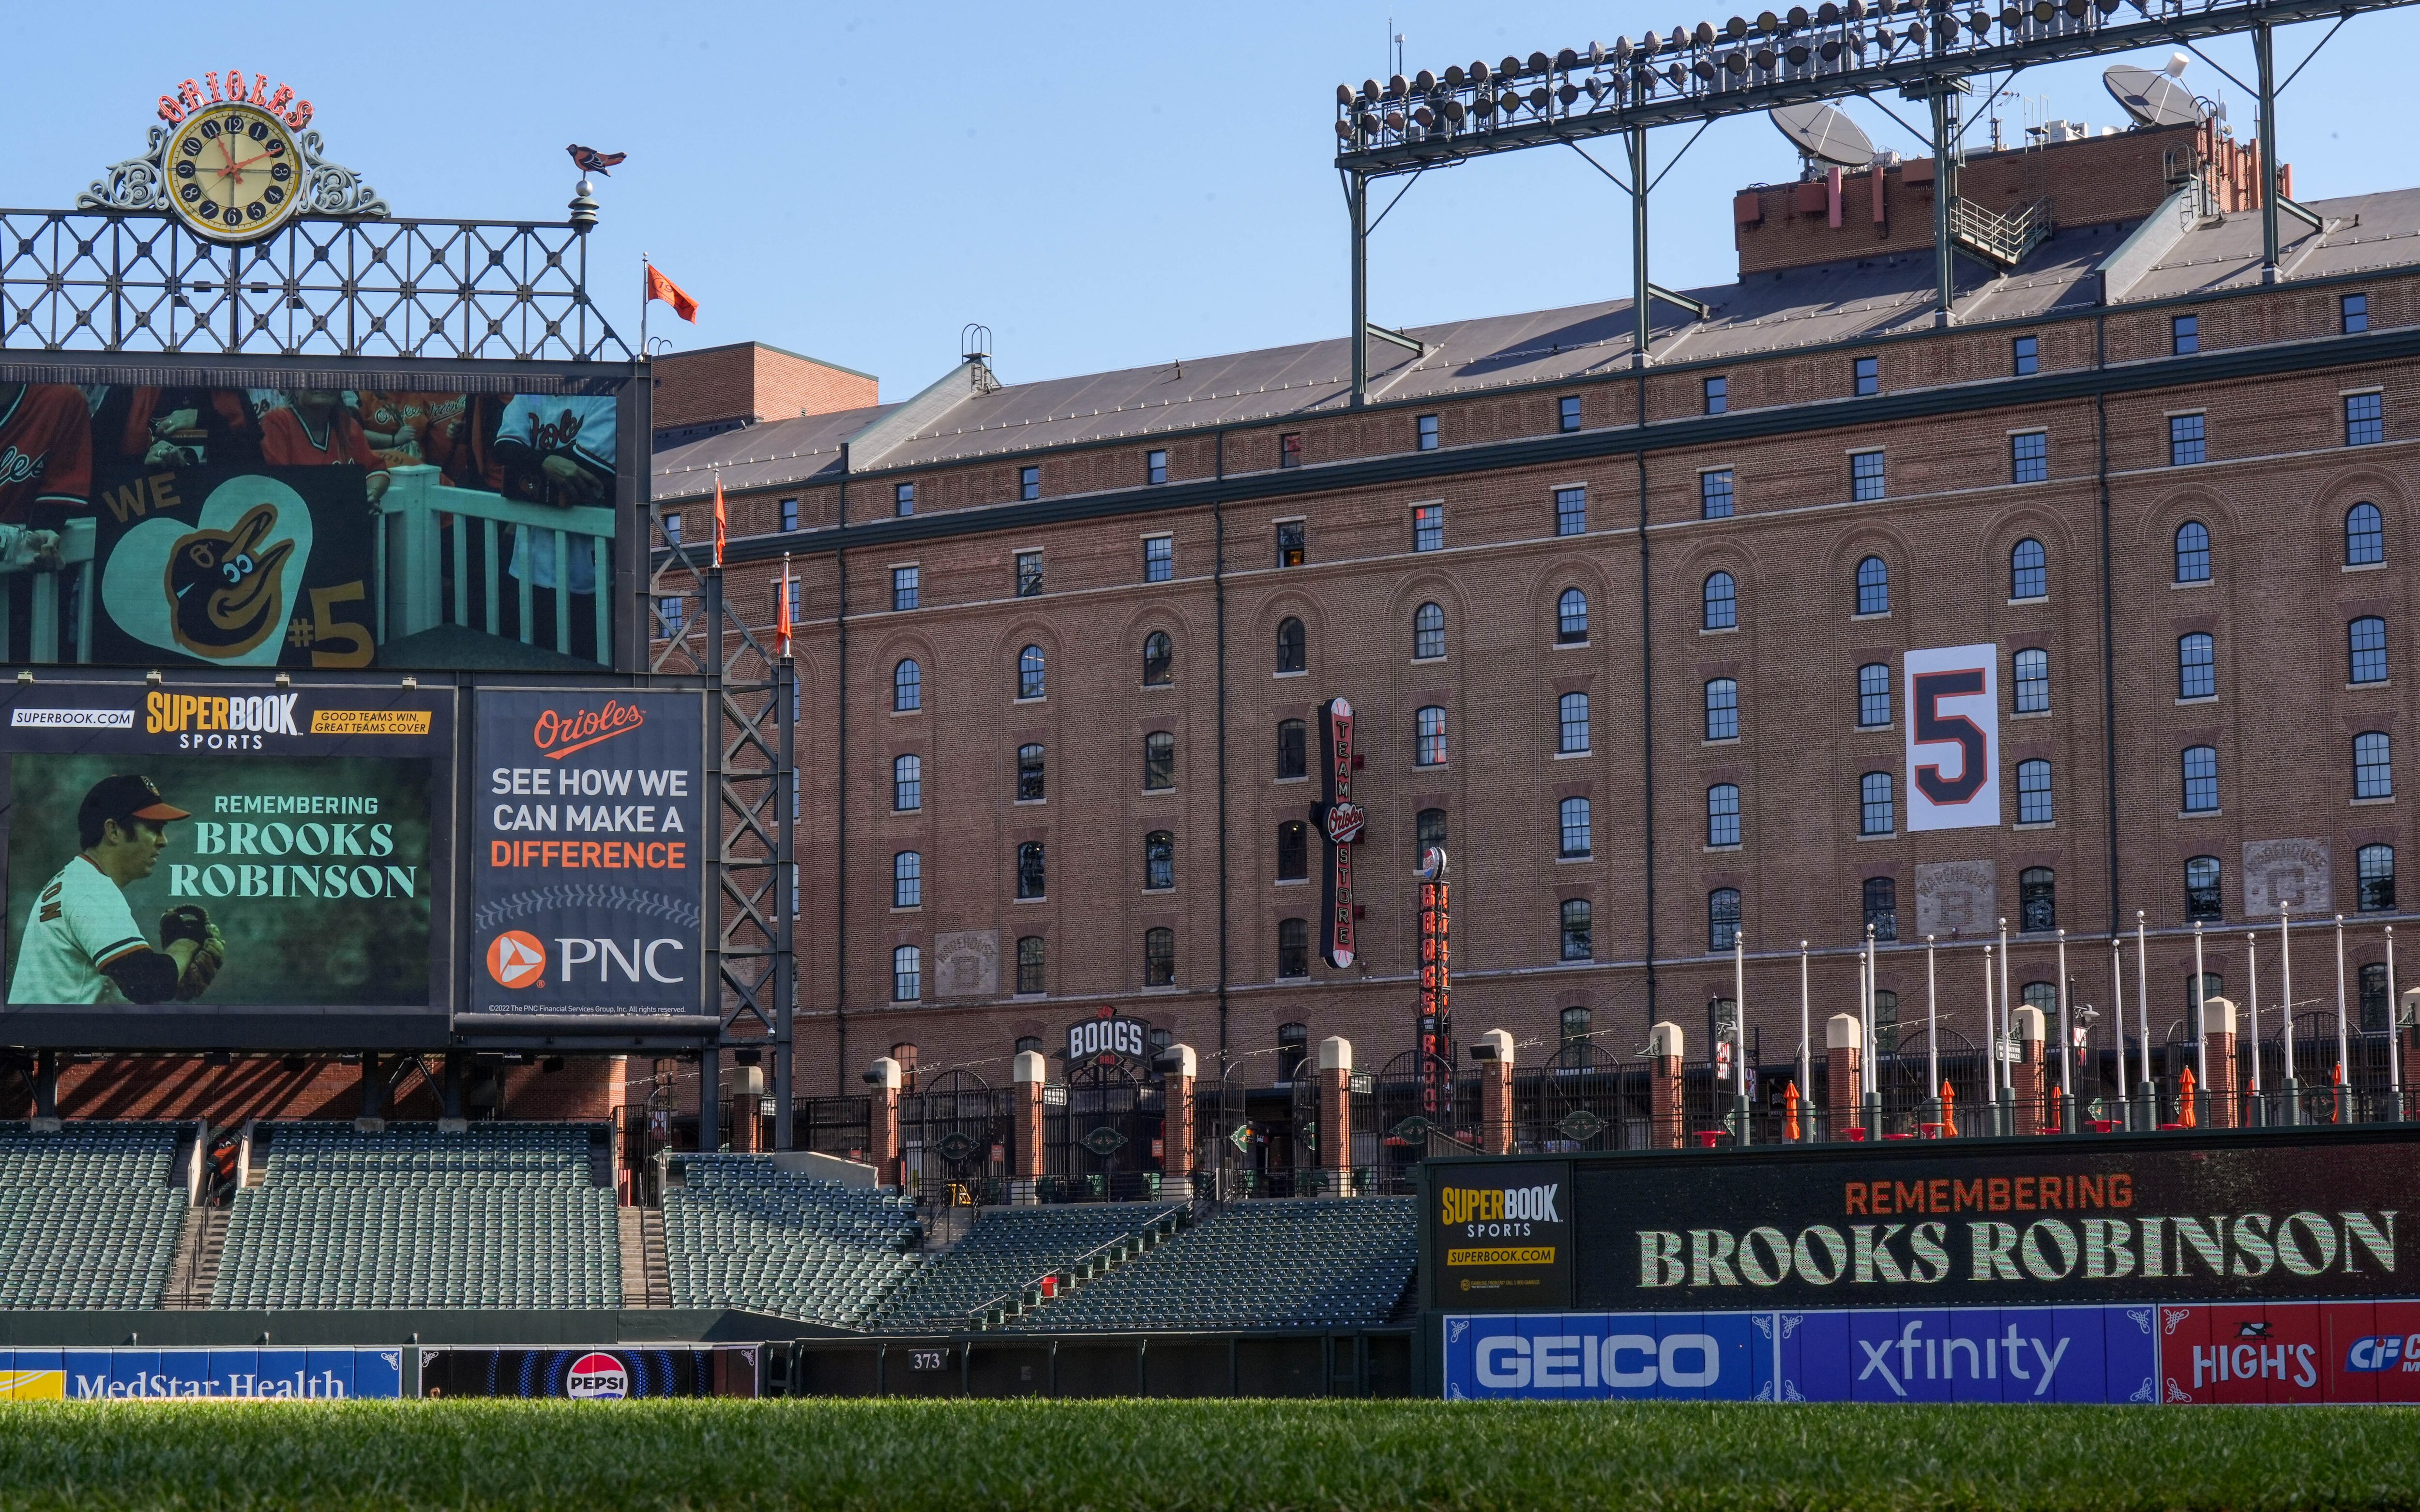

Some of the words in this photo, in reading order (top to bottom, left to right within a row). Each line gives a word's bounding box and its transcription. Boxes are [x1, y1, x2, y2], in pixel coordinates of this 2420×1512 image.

[158, 70, 315, 131] ORIOLES
[203, 123, 218, 138] 11
[227, 118, 243, 132] 12
[253, 125, 262, 137] 1
[184, 139, 200, 155] 10
[178, 165, 193, 174] 9
[274, 167, 287, 177] 3
[184, 188, 198, 199] 8
[268, 189, 281, 202] 4
[203, 205, 218, 215] 7
[227, 210, 237, 224] 6
[251, 204, 261, 218] 5
[102, 472, 181, 522] WE
[16, 713, 130, 724] SUPERBOOK.COM
[147, 691, 298, 736] SUPERBOOK
[321, 712, 356, 721] GOOD
[359, 713, 393, 721] TEAMS
[396, 713, 419, 722] WIN,
[180, 734, 262, 749] SPORTS
[315, 723, 349, 732] GREAT
[352, 723, 385, 732] TEAMS
[389, 723, 425, 733] COVER
[534, 700, 645, 759] Orioles
[1912, 668, 1987, 806] 5
[1337, 721, 1349, 797] TEAM
[492, 768, 551, 795] SEE
[560, 769, 632, 796] HOW
[636, 770, 688, 796] WE
[215, 796, 378, 815] REMEMBERING
[493, 804, 556, 831] CAN
[566, 805, 655, 832] MAKE
[661, 806, 684, 832] A
[1329, 804, 1364, 838] Orioles
[194, 822, 393, 857] BROOKS
[491, 840, 686, 868] DIFFERENCE
[168, 864, 418, 898] ROBINSON
[1338, 848, 1349, 943] STORE
[555, 938, 684, 983] PNC
[1422, 884, 1436, 1015] BOOGS
[1071, 1020, 1142, 1059] BOOG'S
[1100, 1055, 1116, 1064] BBQ
[1442, 1183, 1559, 1225] SUPERBOOK
[1845, 1173, 2133, 1215] REMEMBERING
[1467, 1222, 1531, 1238] SPORTS
[1451, 1250, 1551, 1262] SUPERBOOK.COM
[1636, 1221, 1950, 1287] BROOKS
[1966, 1210, 2399, 1281] ROBINSON
[914, 1353, 942, 1370] 373
[1476, 1334, 1720, 1388] GEICO
[1858, 1320, 2071, 1396] xfinity
[2193, 1343, 2316, 1389] HIGH'S
[76, 1371, 220, 1399] MedStar
[231, 1369, 345, 1399] Health
[571, 1376, 624, 1390] PEPSI
